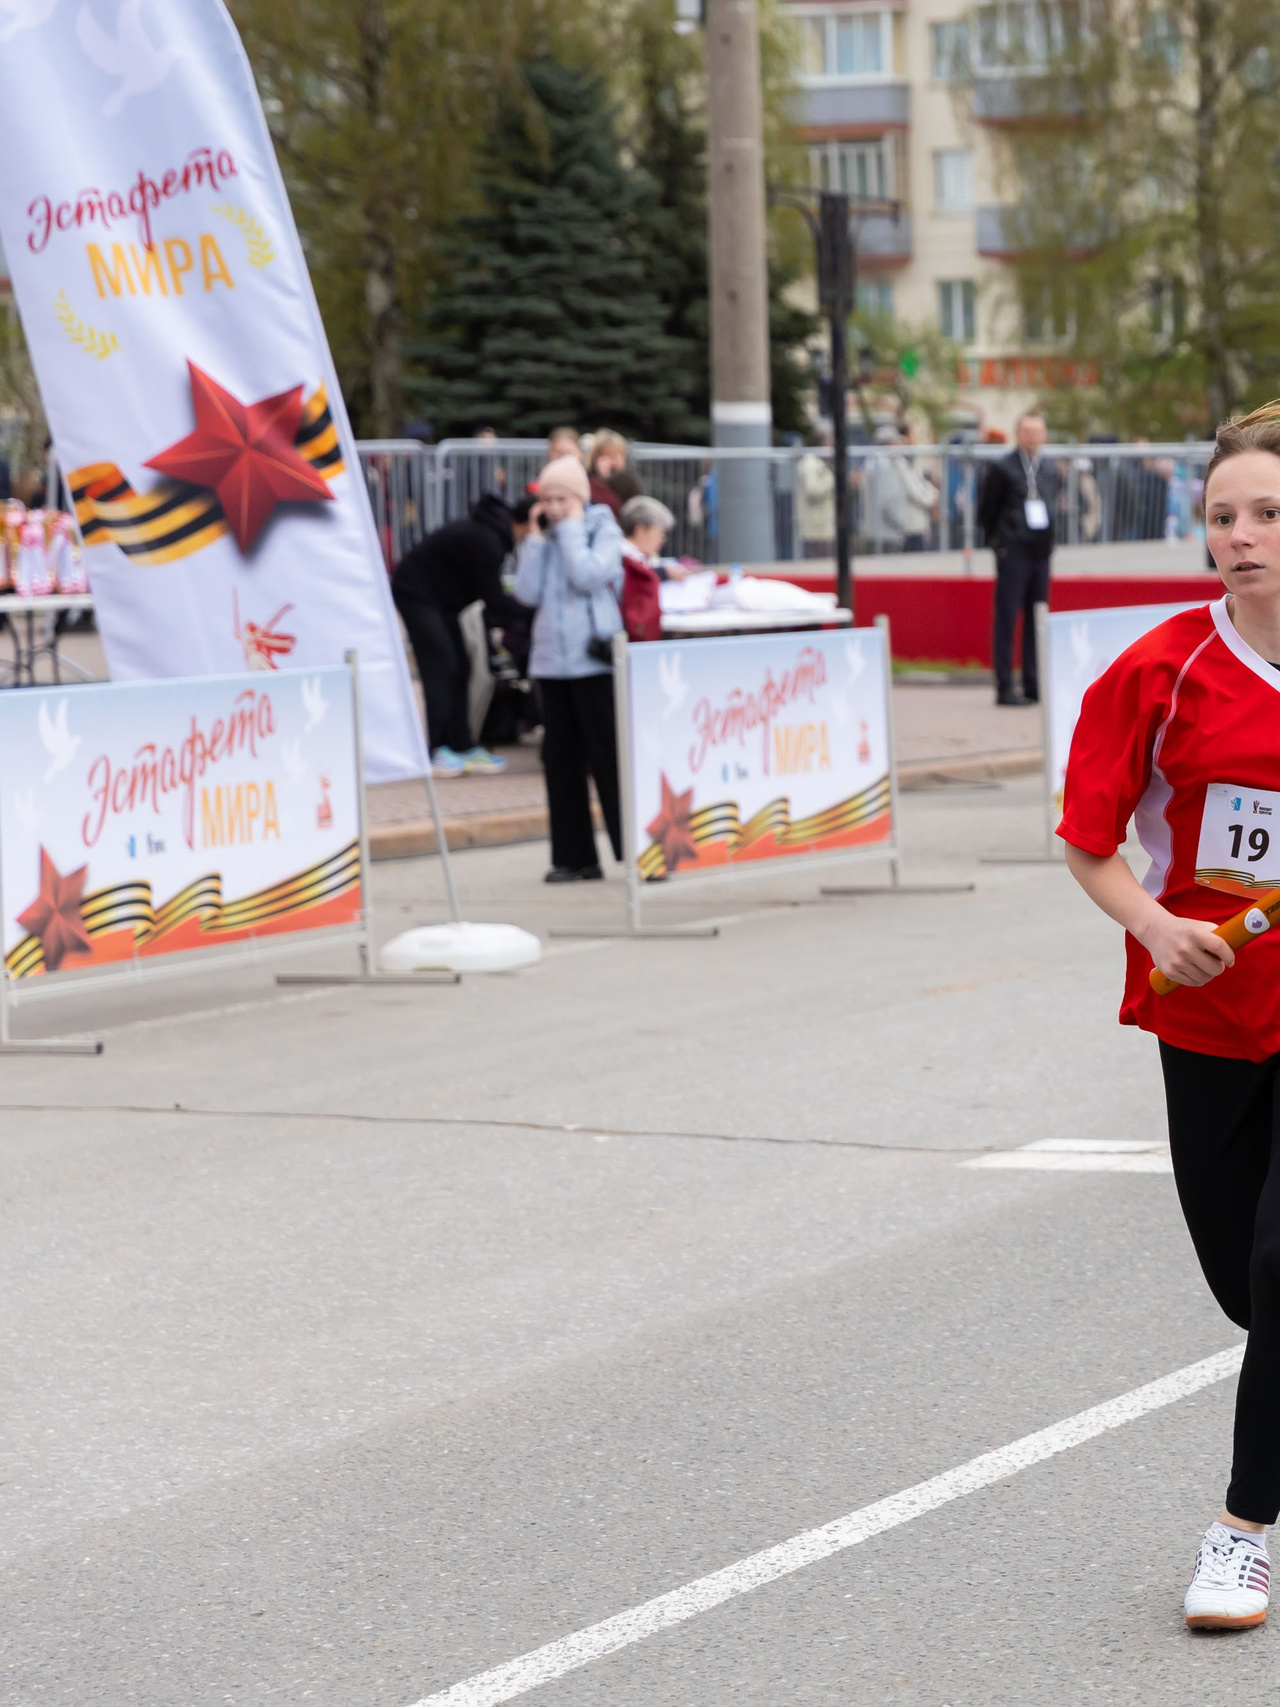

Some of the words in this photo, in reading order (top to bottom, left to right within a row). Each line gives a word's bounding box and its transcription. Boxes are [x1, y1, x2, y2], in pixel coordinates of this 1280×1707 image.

[26, 146, 239, 254] Эстафета
[85, 233, 236, 299] МИРА
[688, 645, 828, 778] Эстафета
[81, 688, 277, 851] Эстафета
[201, 779, 281, 849] МИРА
[1228, 824, 1270, 862] 19
